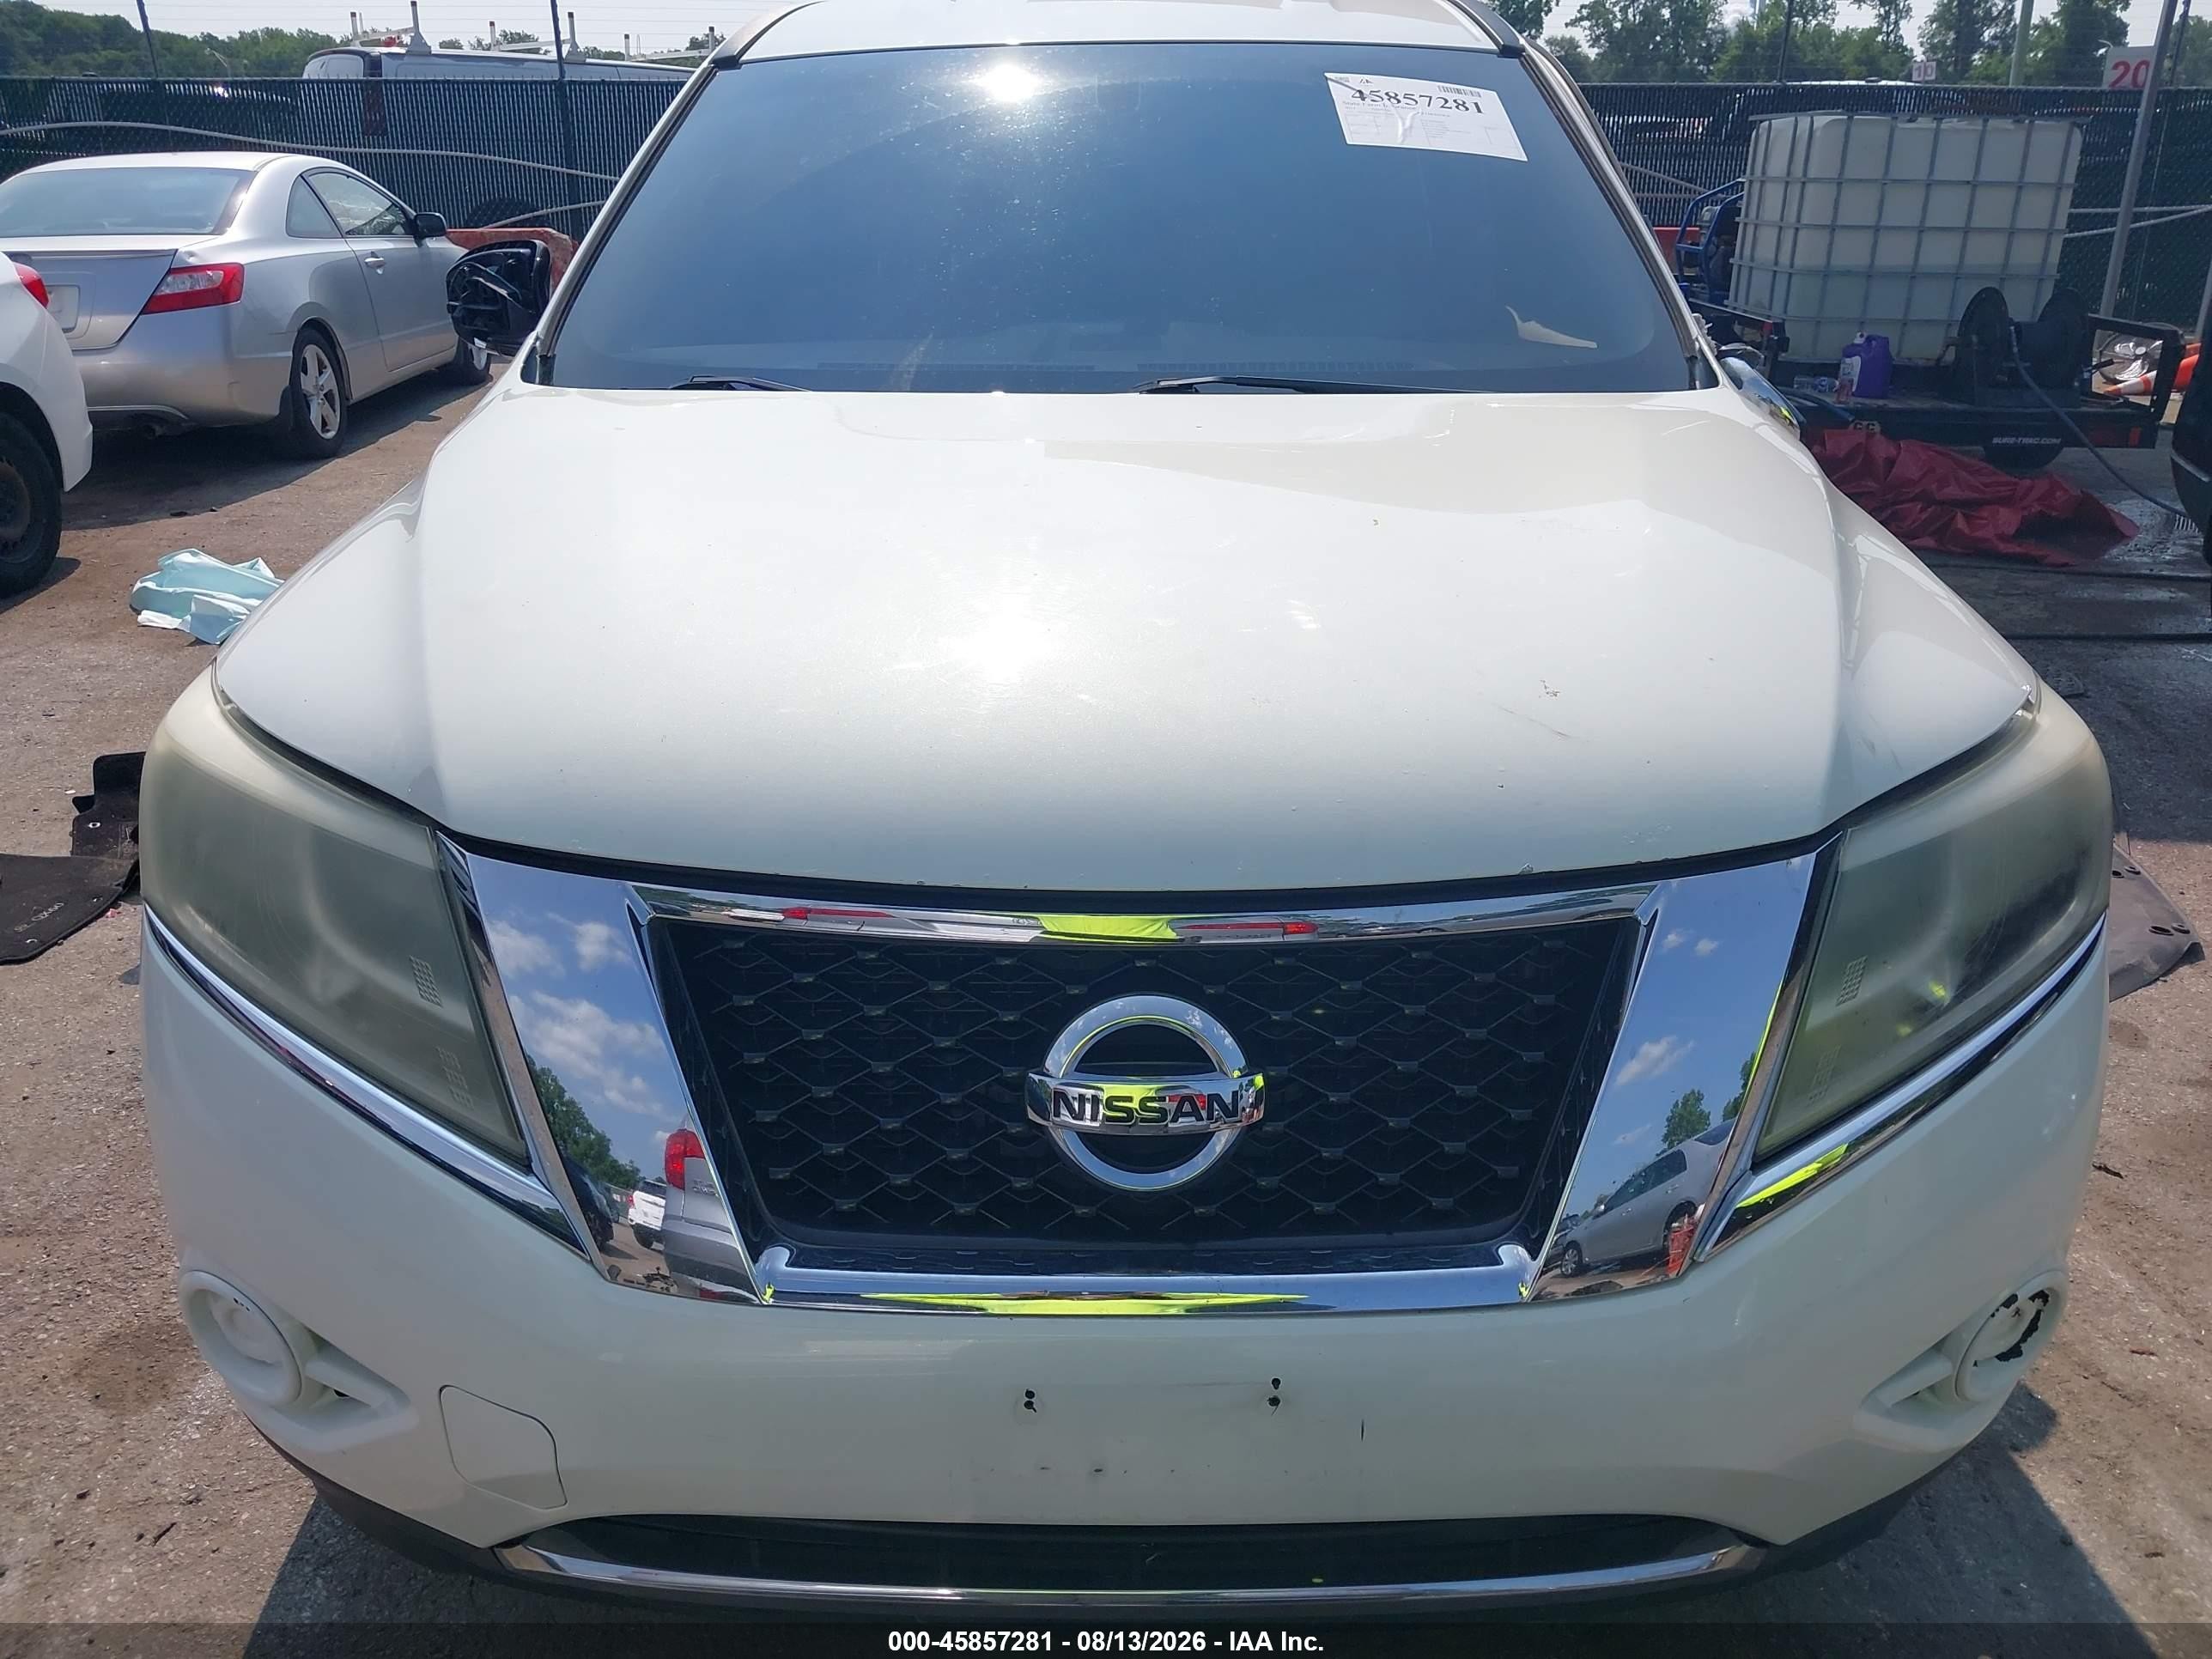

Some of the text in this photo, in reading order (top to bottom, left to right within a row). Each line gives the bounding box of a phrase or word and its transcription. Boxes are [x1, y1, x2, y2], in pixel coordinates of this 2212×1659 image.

[2108, 59, 2151, 88] 20
[1351, 89, 1484, 114] 45857281
[1053, 1088, 1239, 1125] NISSAN
